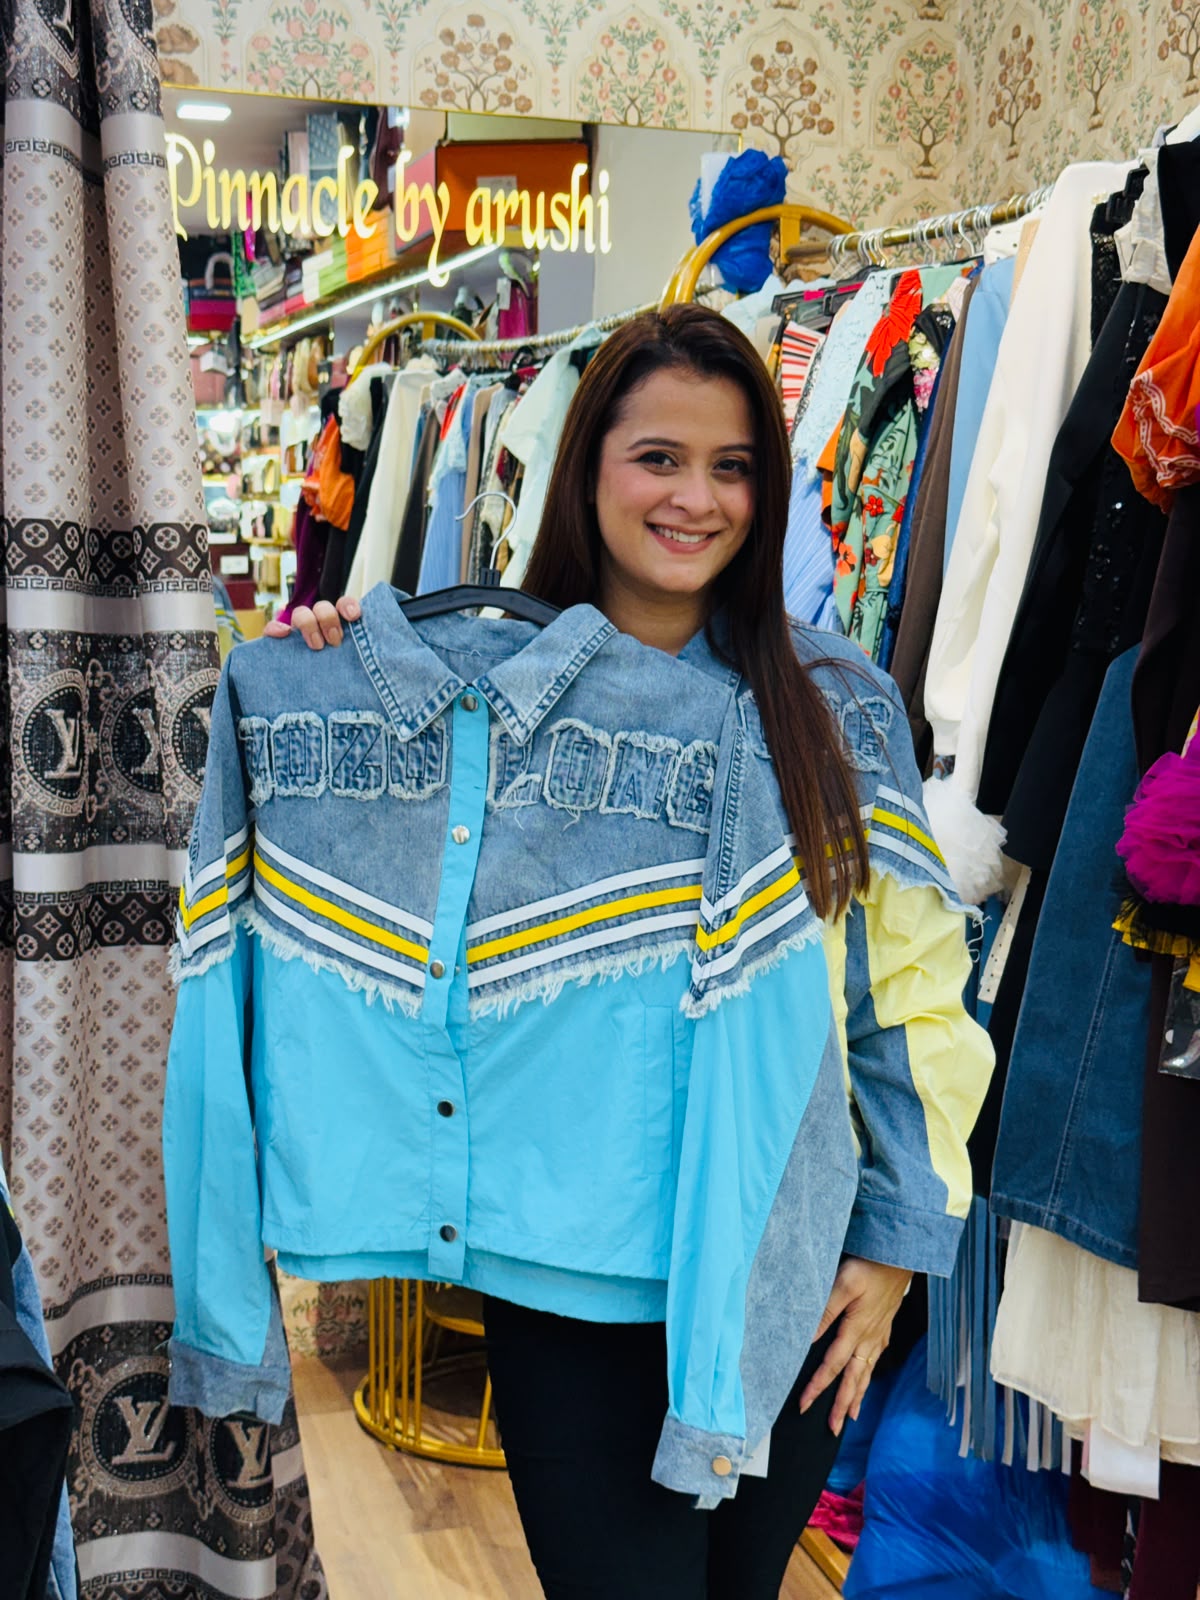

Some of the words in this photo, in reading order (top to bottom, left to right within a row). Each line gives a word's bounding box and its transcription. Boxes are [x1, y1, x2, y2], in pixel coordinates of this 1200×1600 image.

[164, 133, 379, 242] Pinnacle
[395, 150, 450, 288] by
[465, 162, 612, 255] arushi
